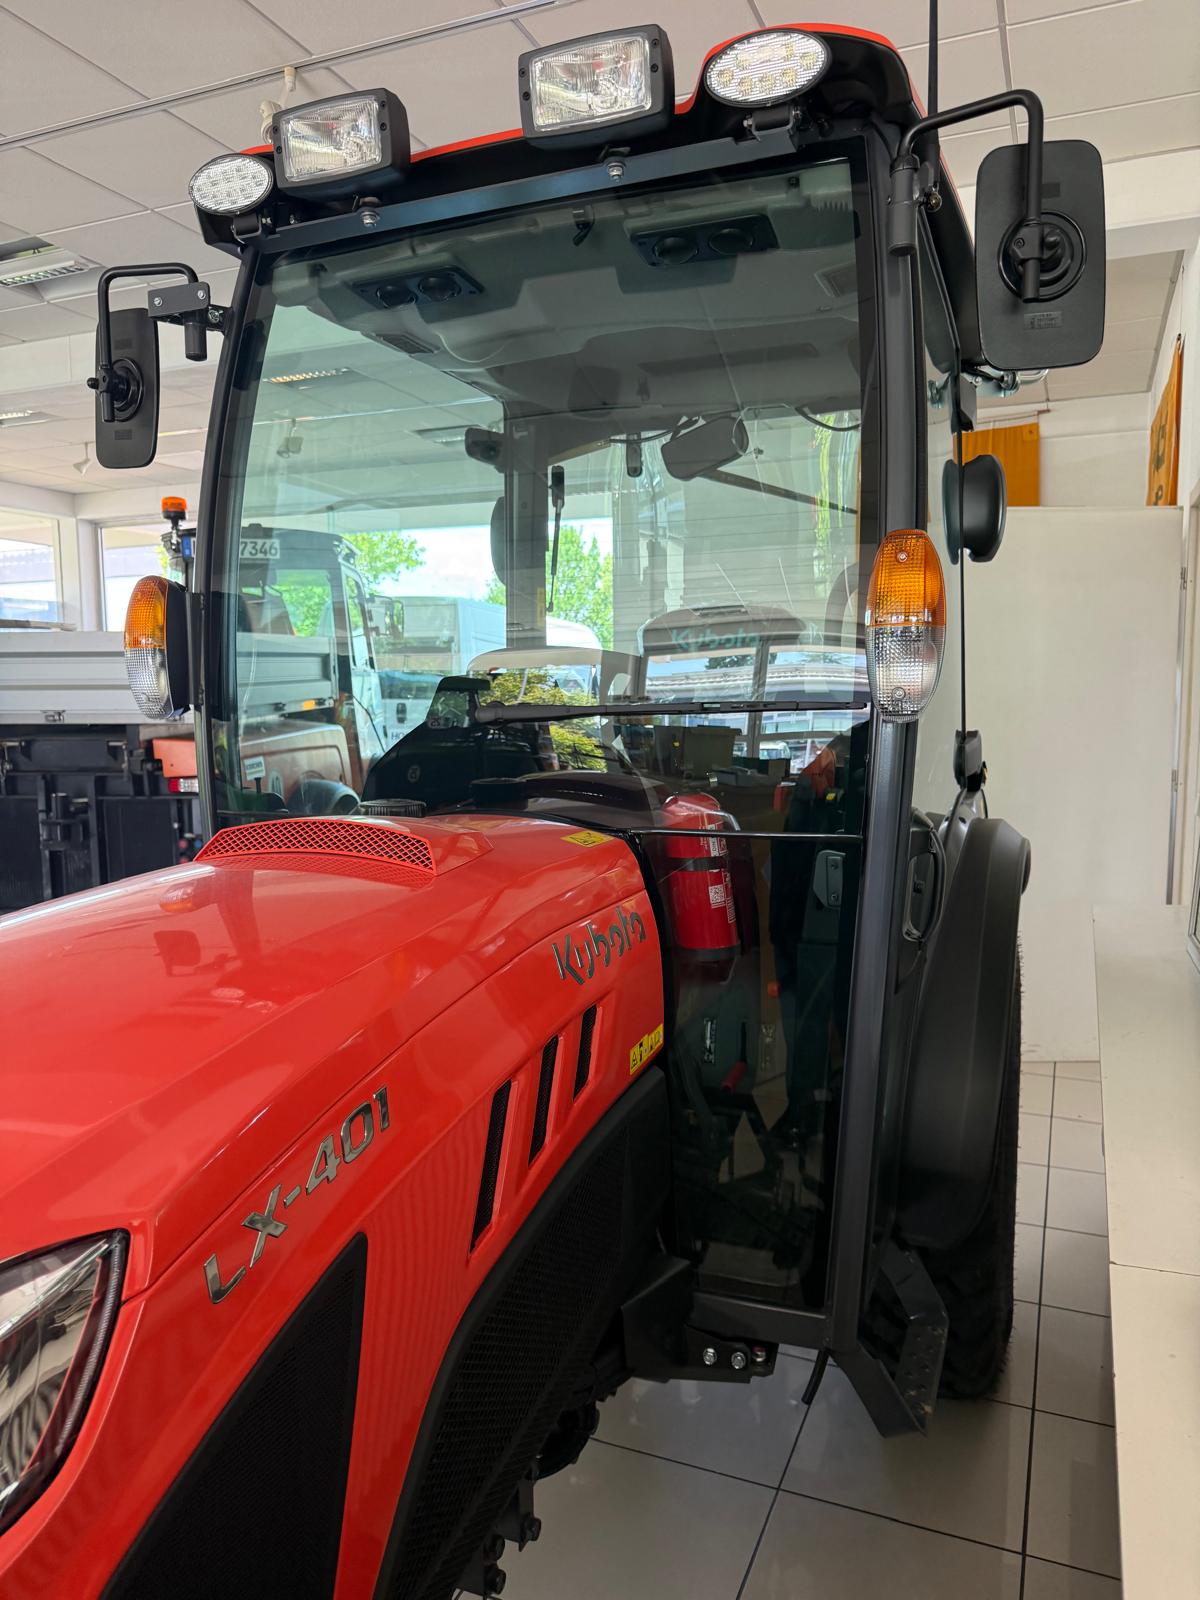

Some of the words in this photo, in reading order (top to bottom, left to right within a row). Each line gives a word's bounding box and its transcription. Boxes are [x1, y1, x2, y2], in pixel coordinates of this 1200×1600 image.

[240, 541, 279, 556] 7346
[552, 906, 646, 985] Kubota
[203, 1085, 390, 1304] LX-401
